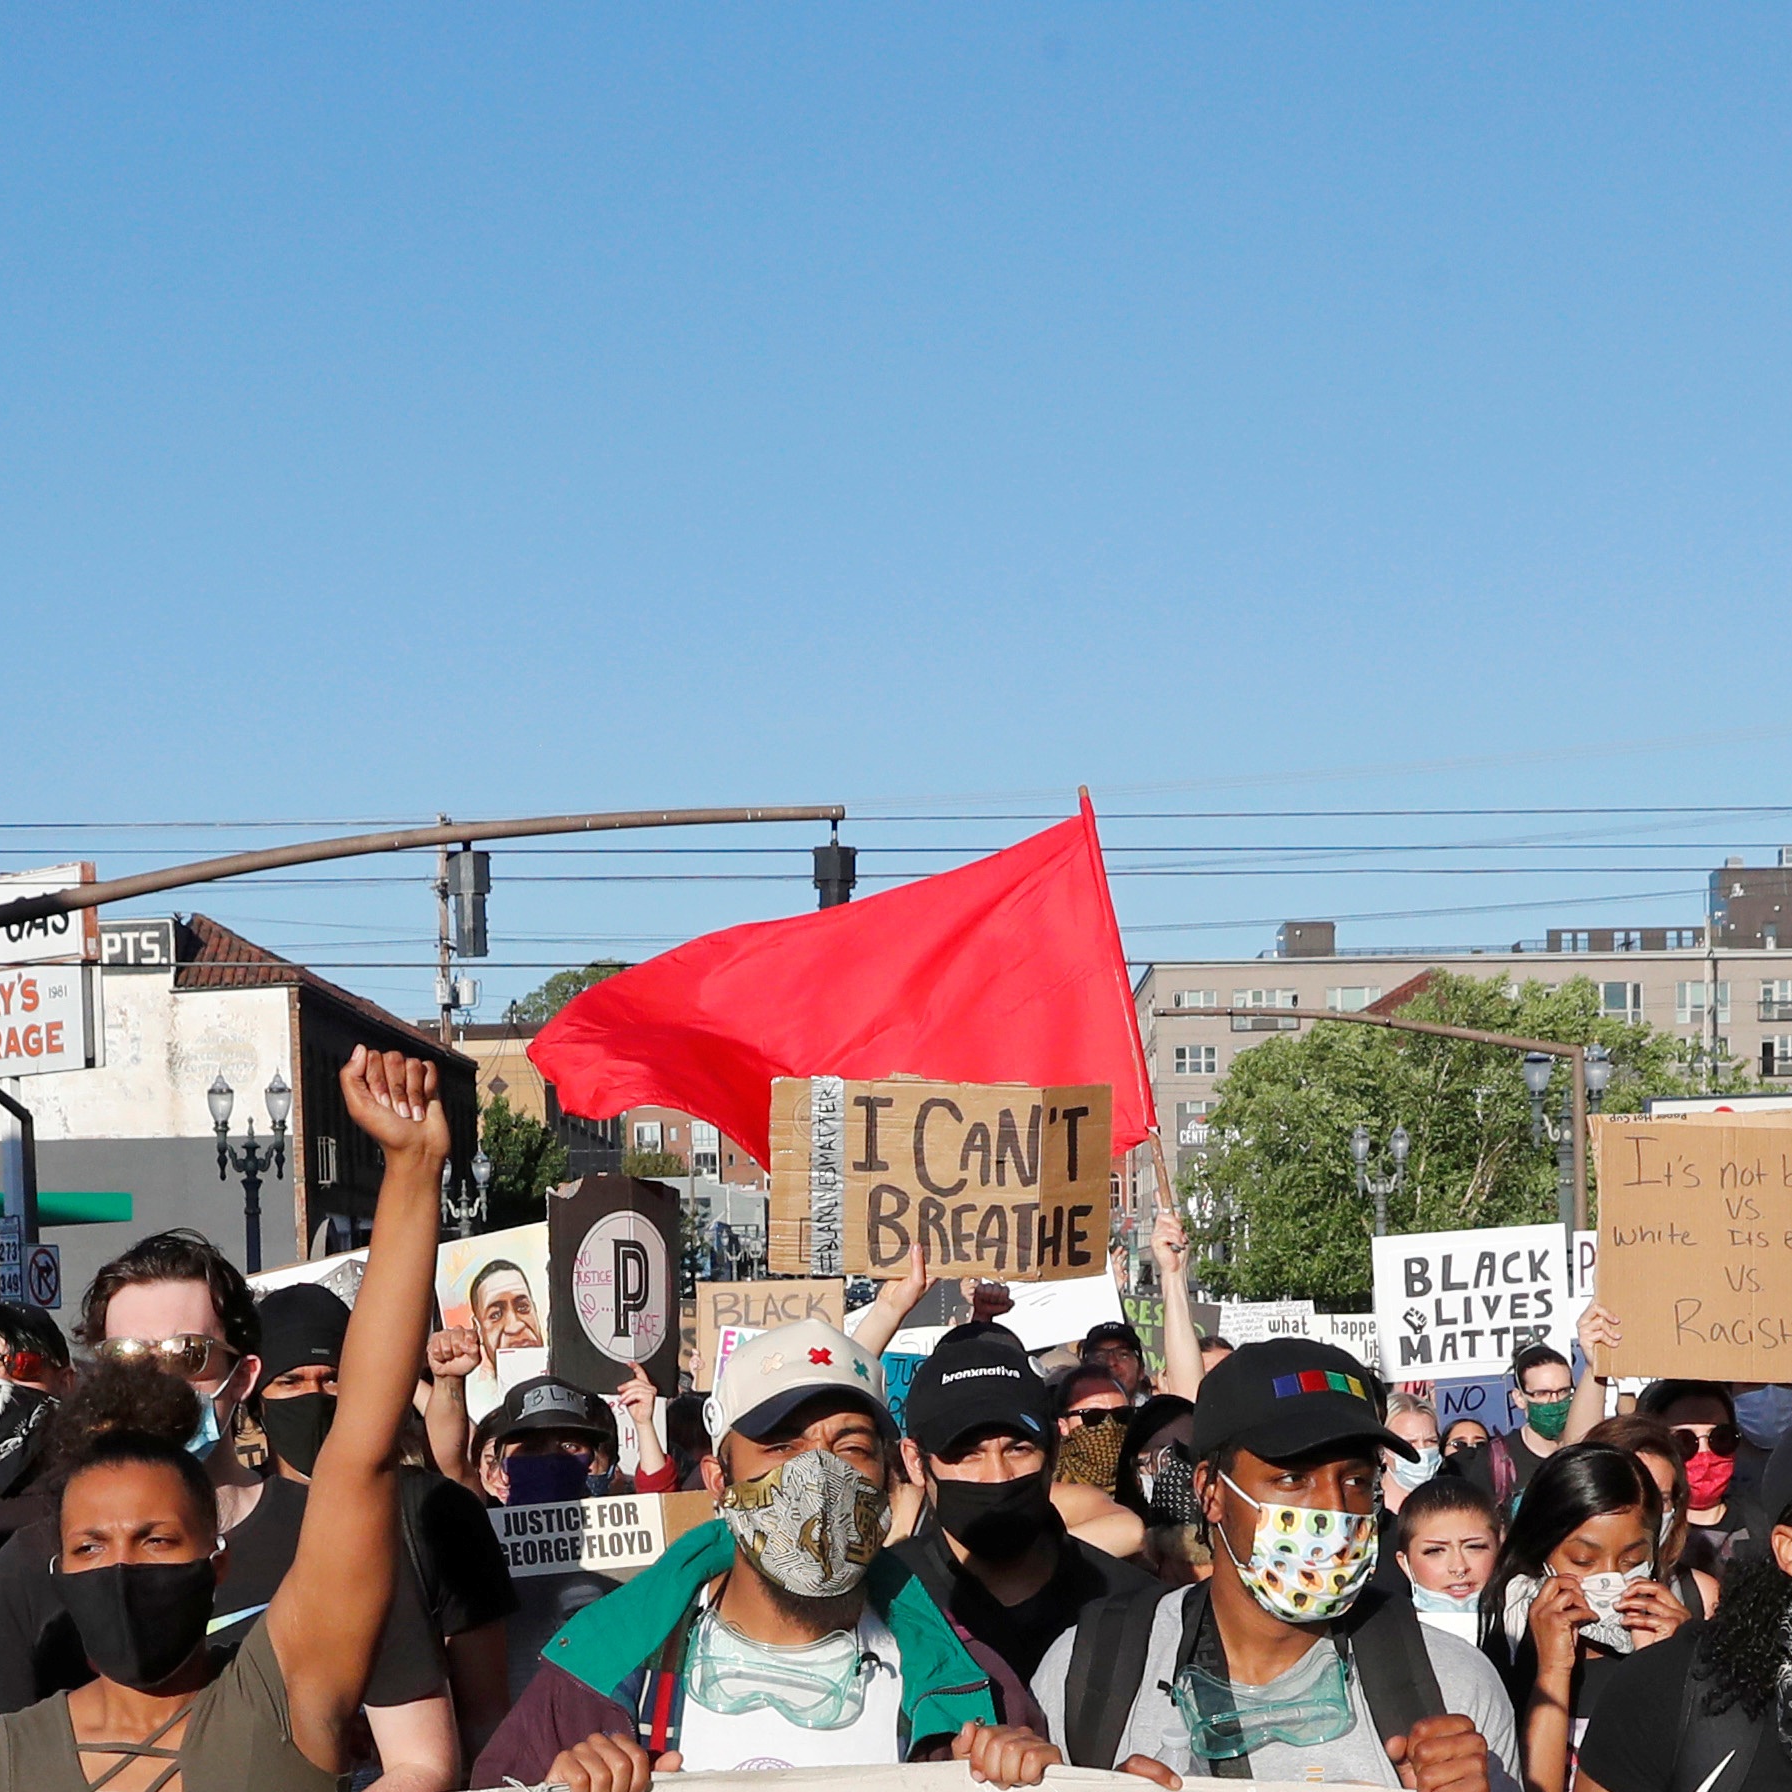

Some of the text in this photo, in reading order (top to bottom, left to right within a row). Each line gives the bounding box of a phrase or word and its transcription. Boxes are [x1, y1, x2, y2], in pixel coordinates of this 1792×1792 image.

[102, 931, 169, 966] PTS.
[47, 985, 69, 1000] 1981
[1609, 1113, 1630, 1124] Cup
[853, 1096, 1090, 1199] I CAN'T
[1622, 1136, 1701, 1189] It's
[1719, 1159, 1769, 1190] not
[867, 1183, 1093, 1271] BREATHE
[575, 1270, 613, 1286] JUSTICE
[1404, 1249, 1551, 1298] BLACK
[712, 1292, 832, 1330] BLACK
[1434, 1288, 1554, 1328] LIVES
[1267, 1315, 1311, 1336] what
[1330, 1315, 1377, 1341] happe
[941, 1364, 1022, 1386] bronxnative
[1443, 1385, 1487, 1415] NO
[504, 1502, 640, 1538] JUSTICE FOR
[586, 1530, 653, 1559] FLOYD
